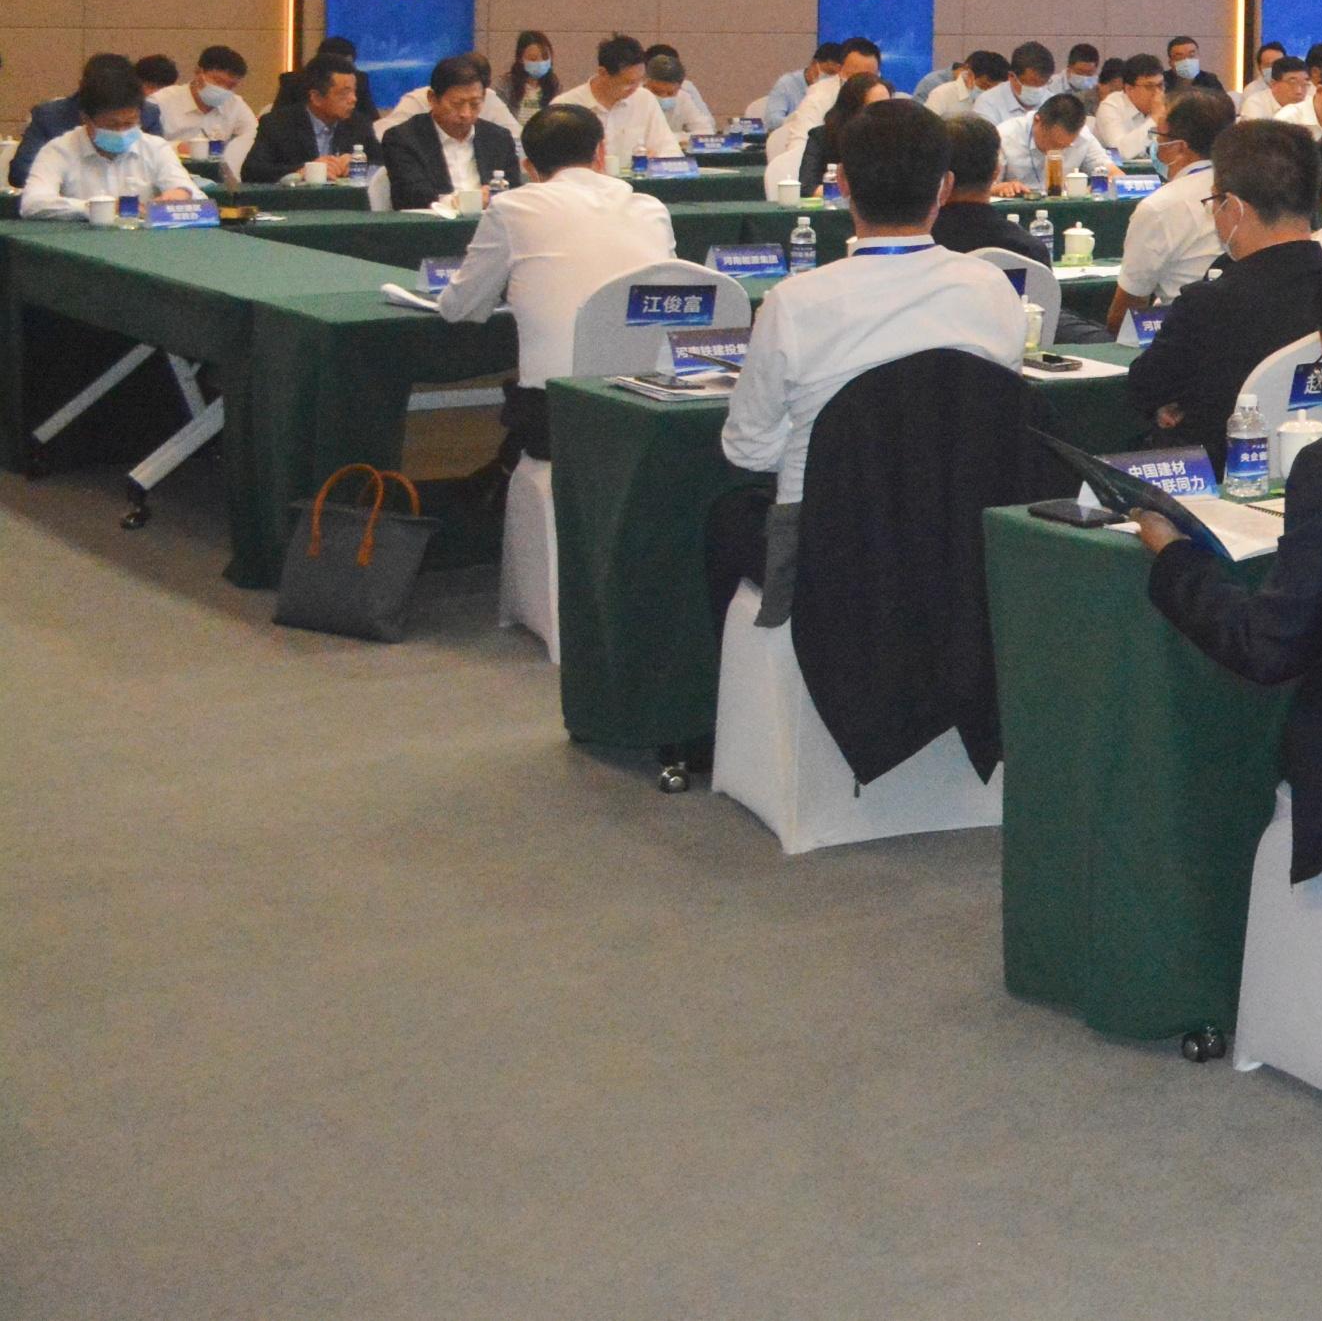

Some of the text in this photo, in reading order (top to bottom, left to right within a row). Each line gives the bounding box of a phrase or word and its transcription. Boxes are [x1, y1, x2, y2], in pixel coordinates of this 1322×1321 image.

[642, 295, 703, 313] 江俊富
[1127, 460, 1187, 478] 中国建材
